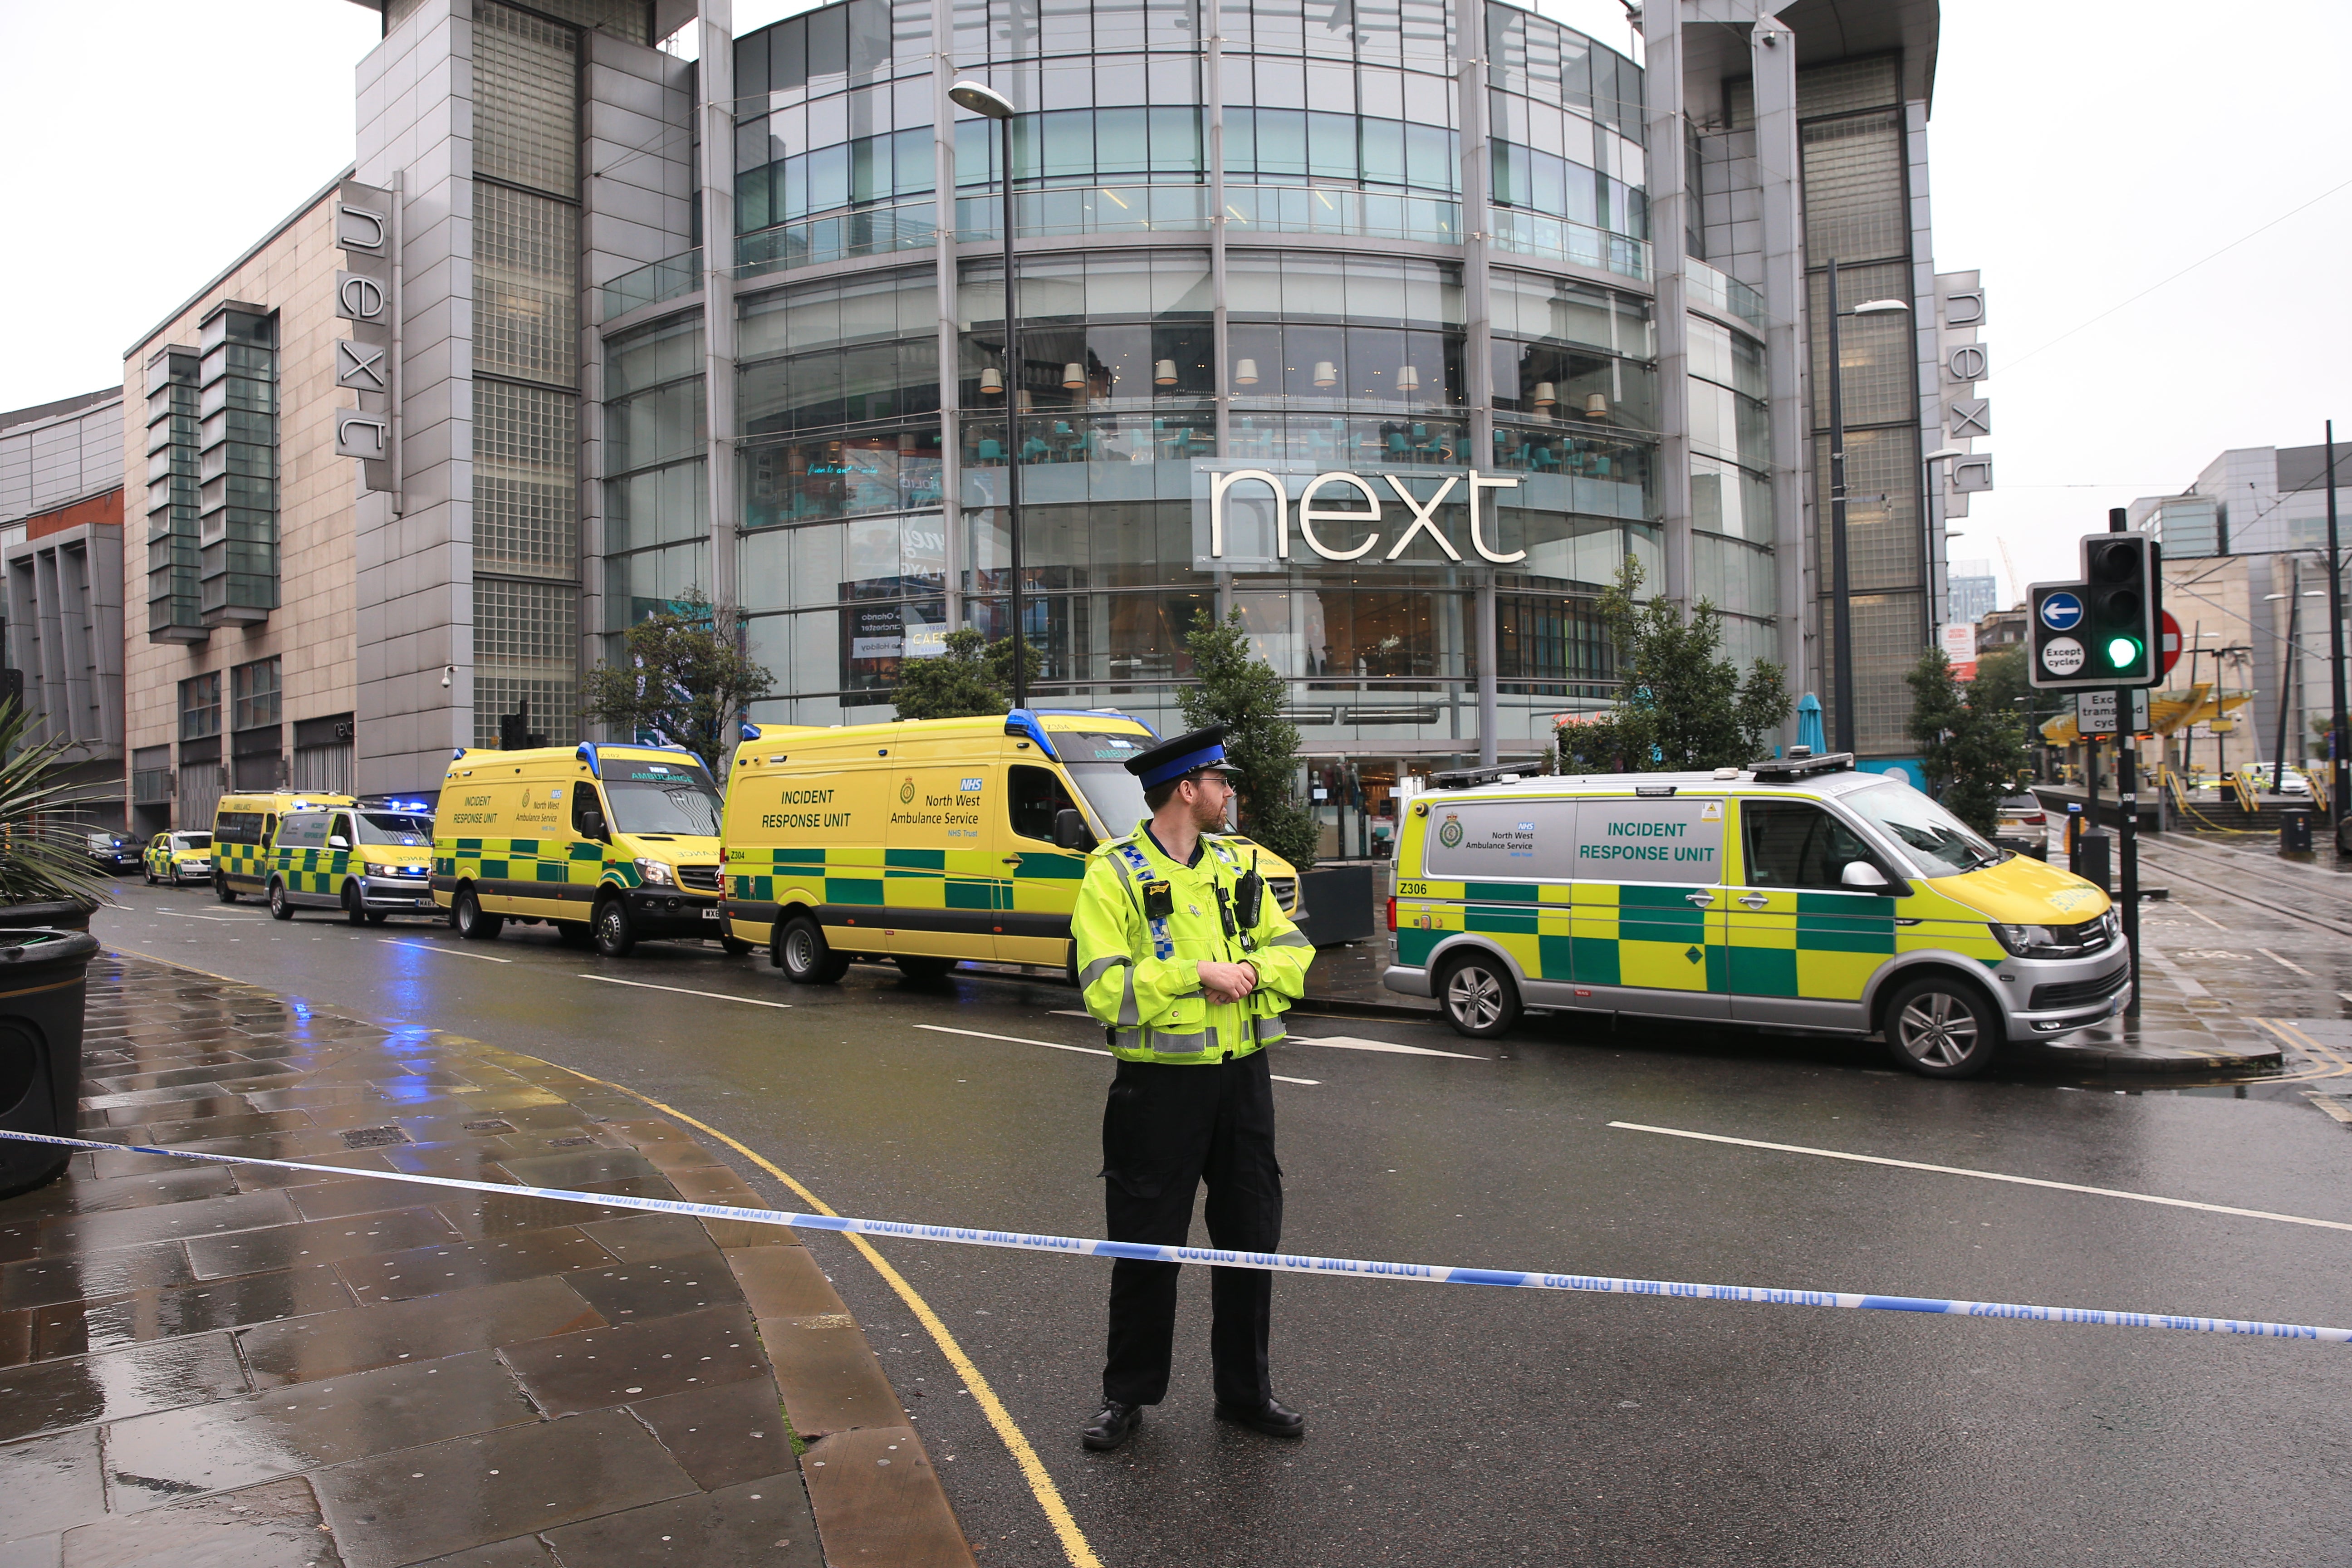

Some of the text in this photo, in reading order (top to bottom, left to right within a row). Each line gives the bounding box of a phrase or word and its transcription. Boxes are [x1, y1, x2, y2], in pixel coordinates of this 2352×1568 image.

[340, 206, 386, 449] next
[1947, 292, 1991, 485] next
[1210, 468, 1528, 564] next
[2047, 647, 2081, 657] Except
[2048, 657, 2080, 667] cycles
[631, 772, 695, 784] AMBULANCE
[960, 779, 982, 791] NHS
[465, 795, 492, 806] INCIDENT
[552, 790, 562, 799] NHS
[781, 789, 835, 804] INCIDENT
[926, 794, 980, 806] North West
[533, 801, 559, 810] North West
[453, 813, 498, 823] RESPONSE UNIT
[515, 813, 558, 823] Ambulance Service
[762, 813, 851, 828] RESPONSE UNIT
[890, 812, 978, 824] Ambulance Service
[1607, 822, 1687, 837] INCIDENT
[1465, 841, 1533, 850] Ambulance Service
[731, 851, 745, 859] Z304
[1579, 844, 1715, 862] RESPONSE UNIT
[1400, 883, 1427, 894] Z306
